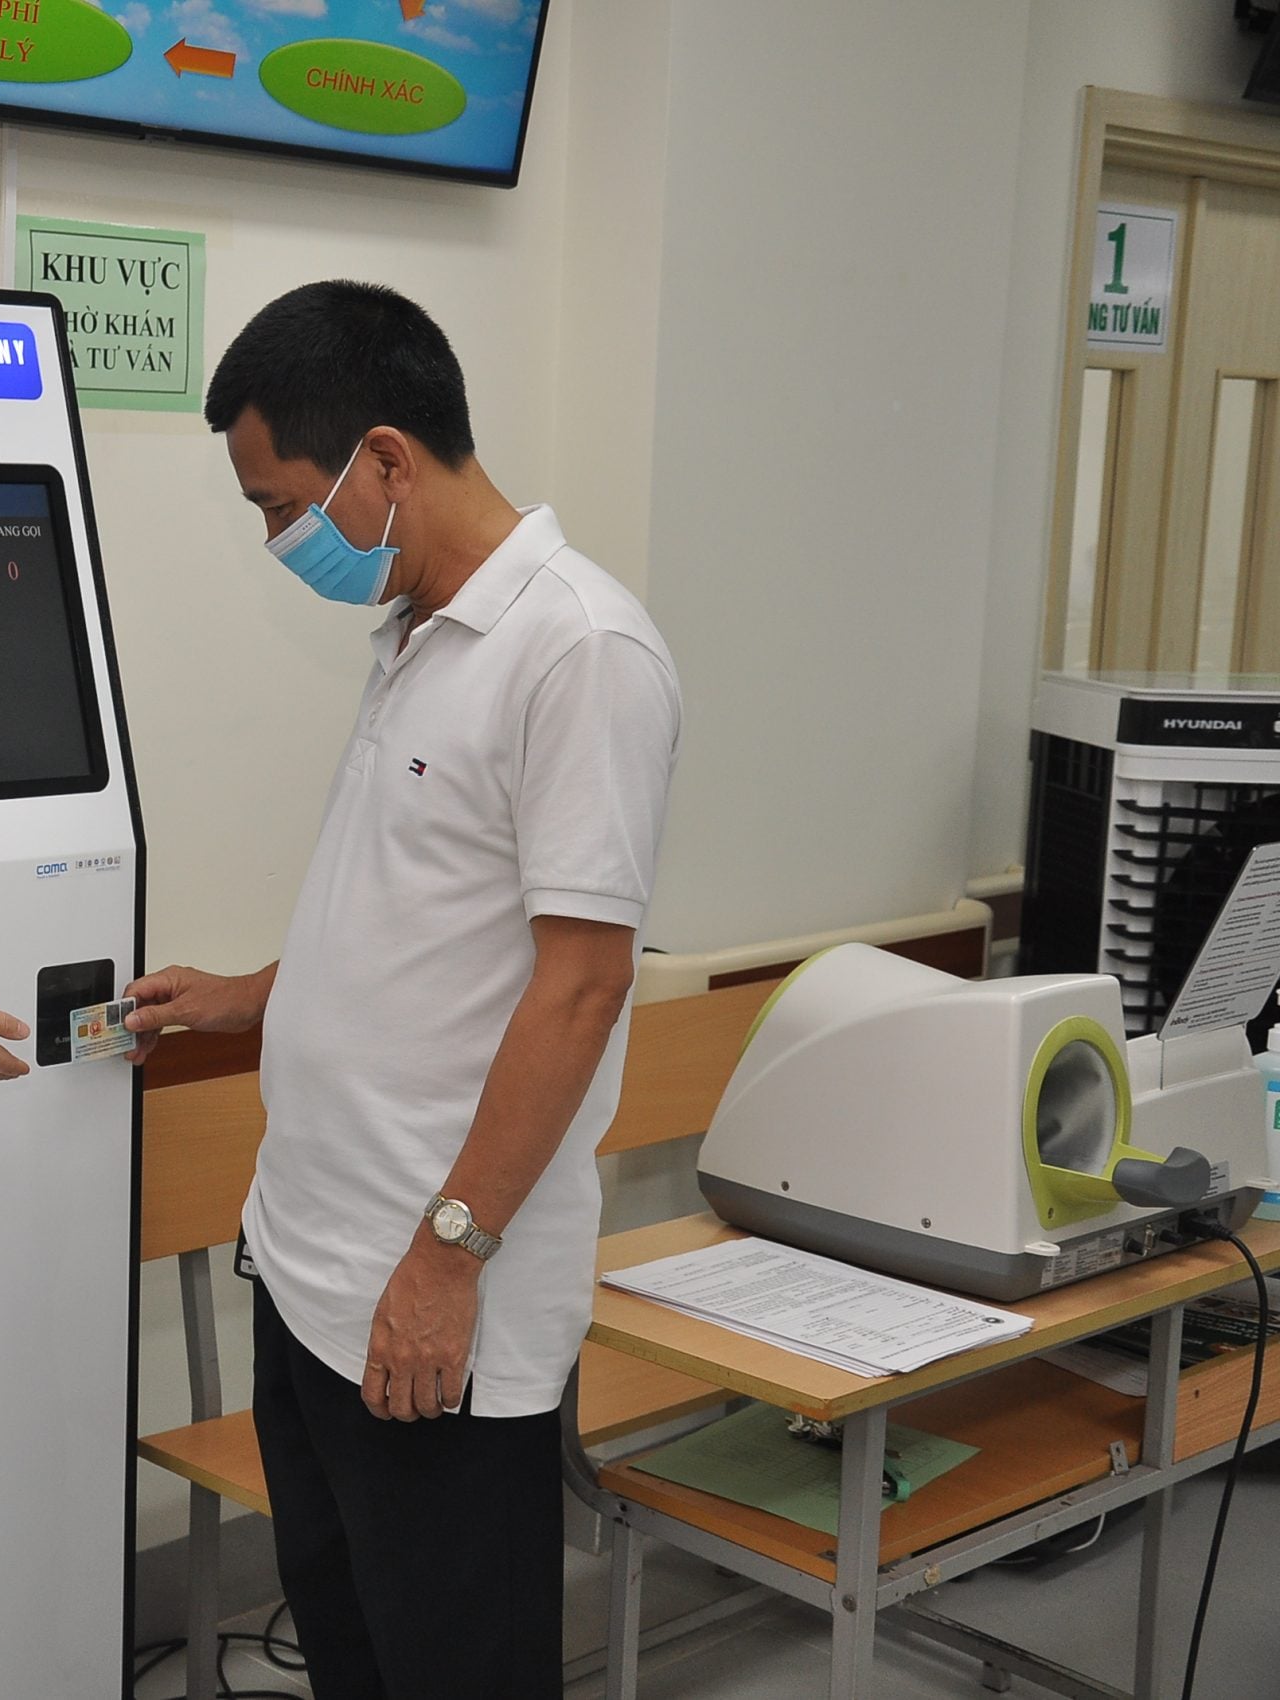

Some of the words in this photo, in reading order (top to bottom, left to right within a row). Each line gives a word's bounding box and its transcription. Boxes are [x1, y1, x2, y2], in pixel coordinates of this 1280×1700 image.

[0, 37, 35, 62] LÝ
[306, 68, 376, 96] CHÍNH
[380, 79, 424, 104] XÁC
[1103, 222, 1129, 295] 1
[41, 252, 108, 284] KHU
[117, 256, 181, 296] VỰC
[64, 305, 99, 334] HỜ
[105, 309, 175, 338] KHÁM
[1112, 303, 1132, 333] TƯ
[1132, 297, 1160, 335] VẤN
[13, 340, 25, 366] Y
[69, 339, 80, 369] À
[87, 346, 121, 370] TƯ
[126, 343, 173, 372] VẤN
[22, 525, 42, 538] GỌI
[7, 560, 19, 581] 0
[1163, 719, 1242, 730] HYUNDAI
[35, 862, 68, 875] coma
